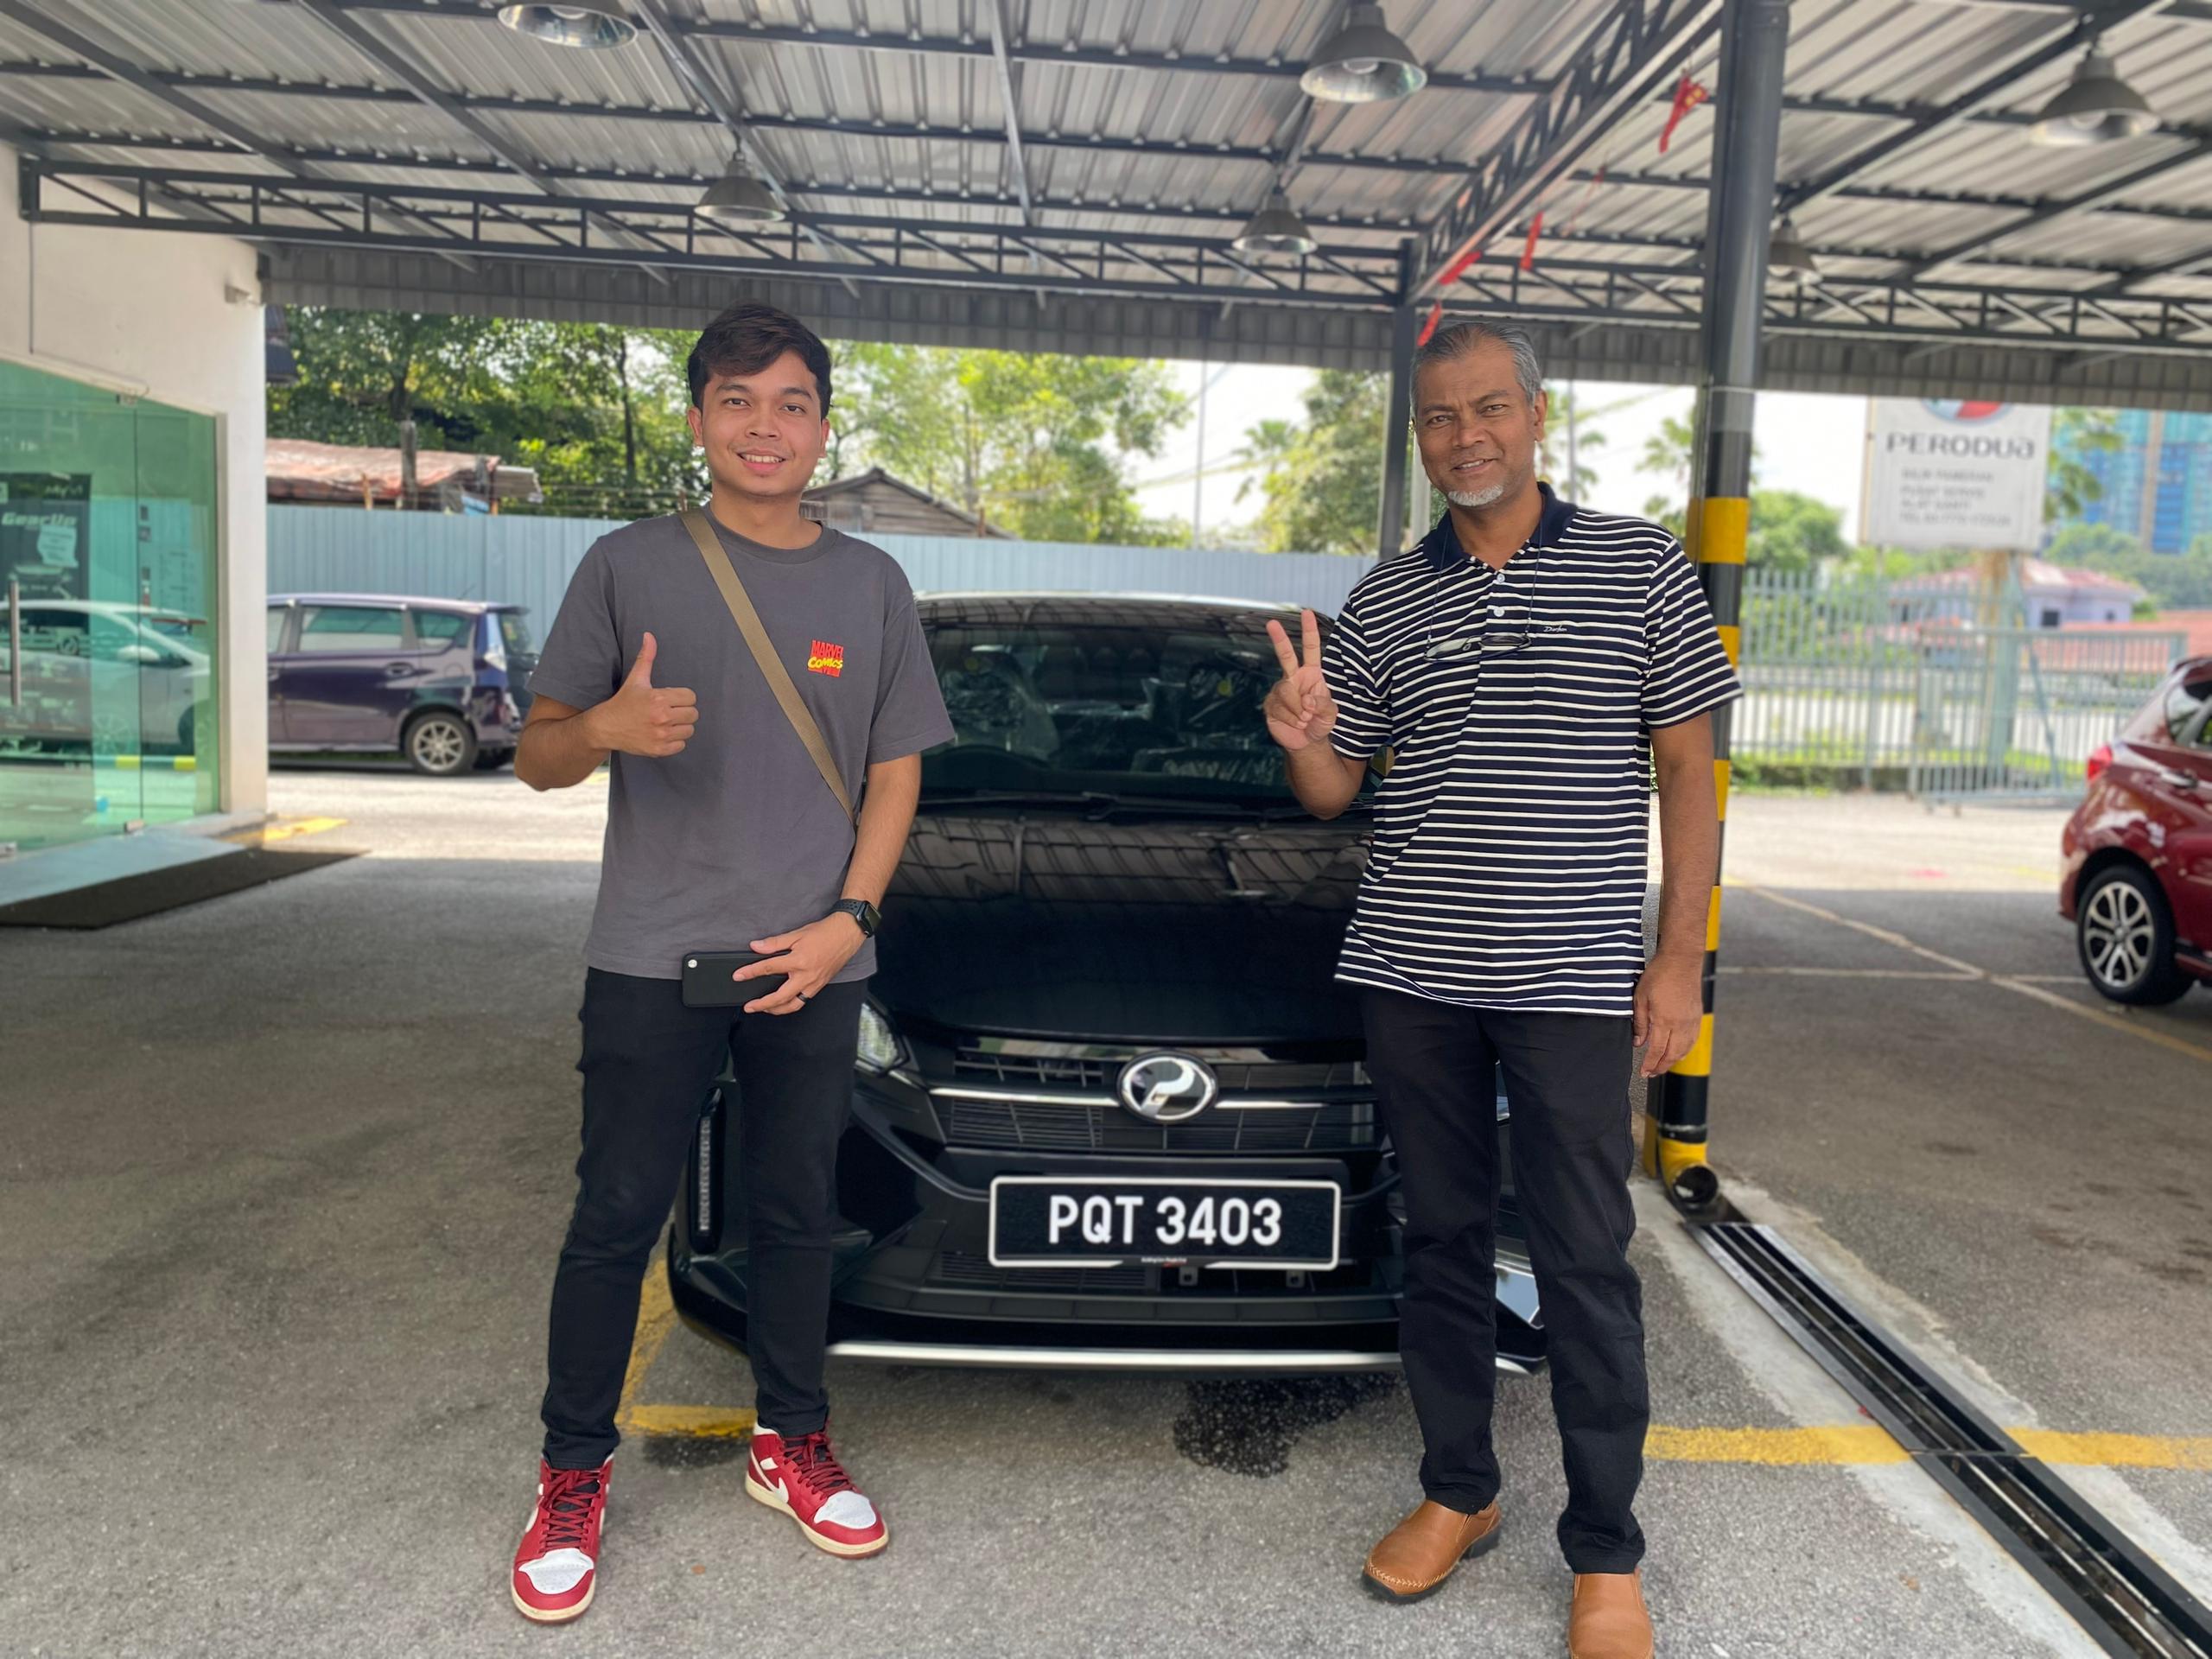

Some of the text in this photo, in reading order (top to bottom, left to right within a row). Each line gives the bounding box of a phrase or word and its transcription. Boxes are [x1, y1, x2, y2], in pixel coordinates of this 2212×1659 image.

[810, 639, 844, 659] MARVEL
[1049, 1195, 1282, 1246] PQT 3403
